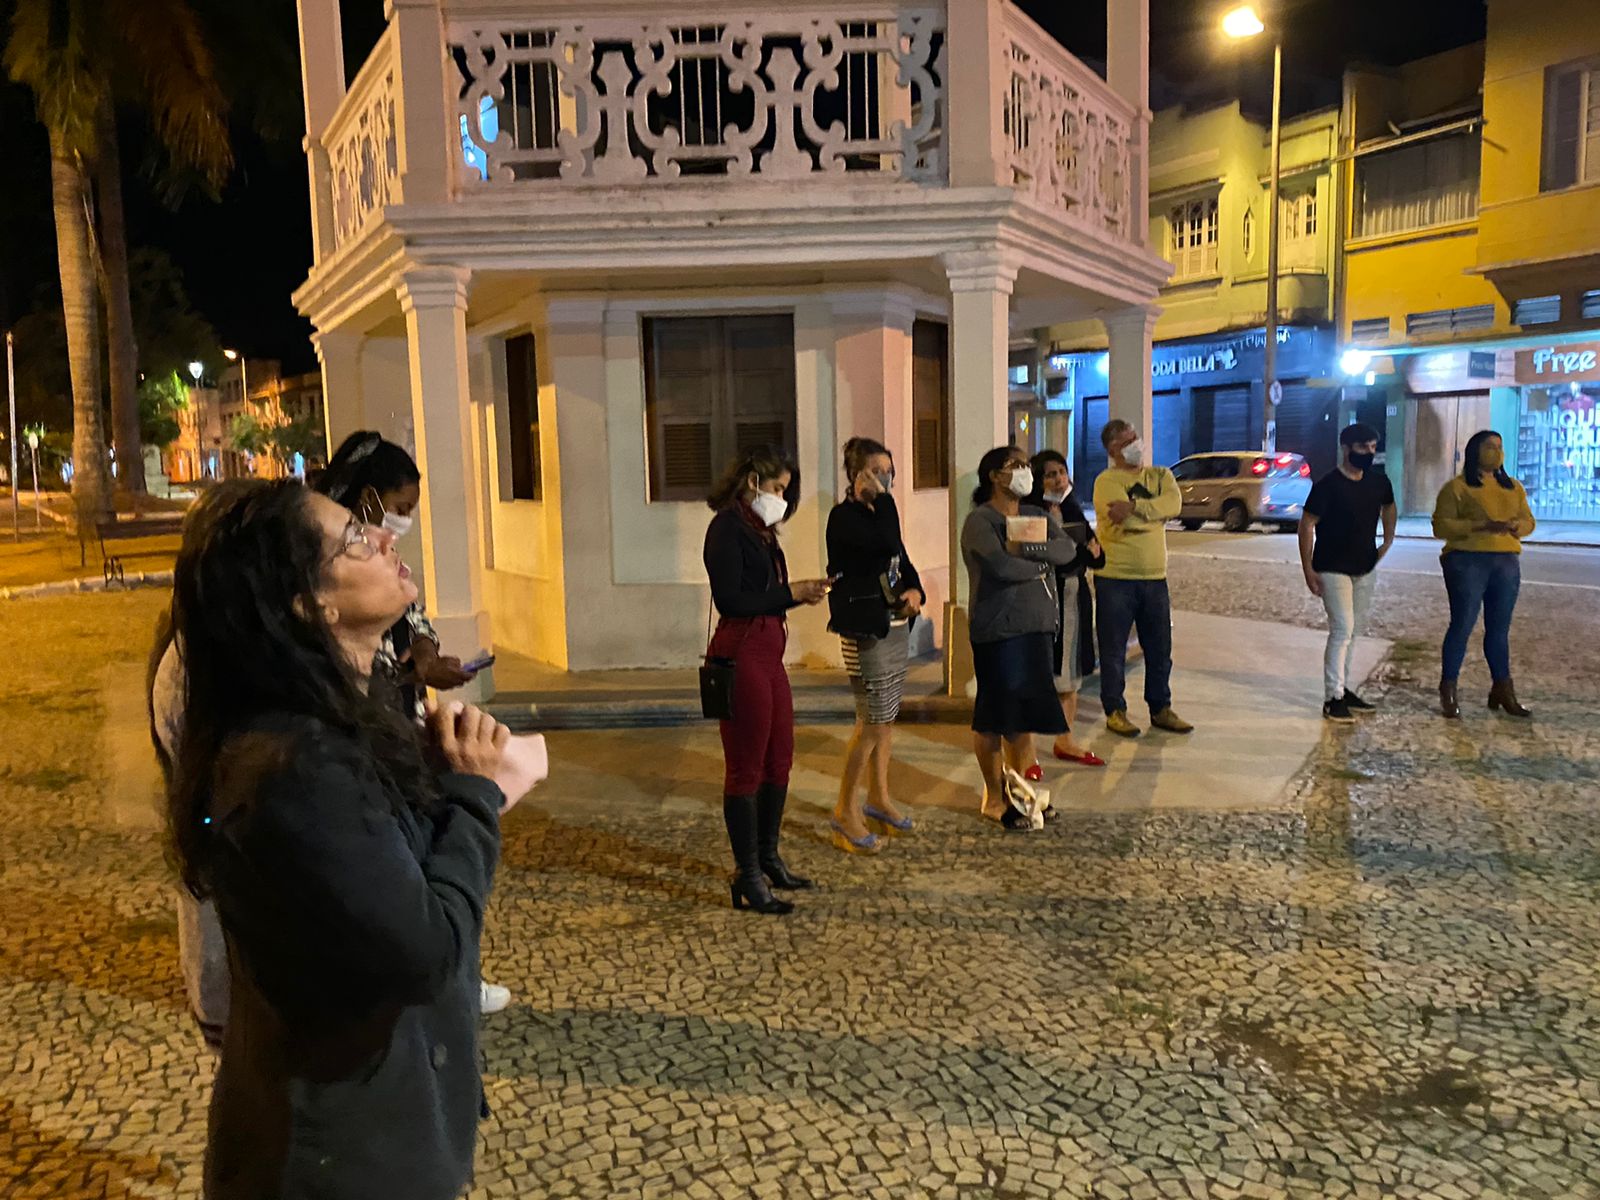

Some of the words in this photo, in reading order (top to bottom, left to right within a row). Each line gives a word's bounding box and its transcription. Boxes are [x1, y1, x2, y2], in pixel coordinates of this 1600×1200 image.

[1151, 359, 1176, 377] ODA
[1179, 353, 1215, 374] BELLA
[1533, 347, 1597, 375] Free
